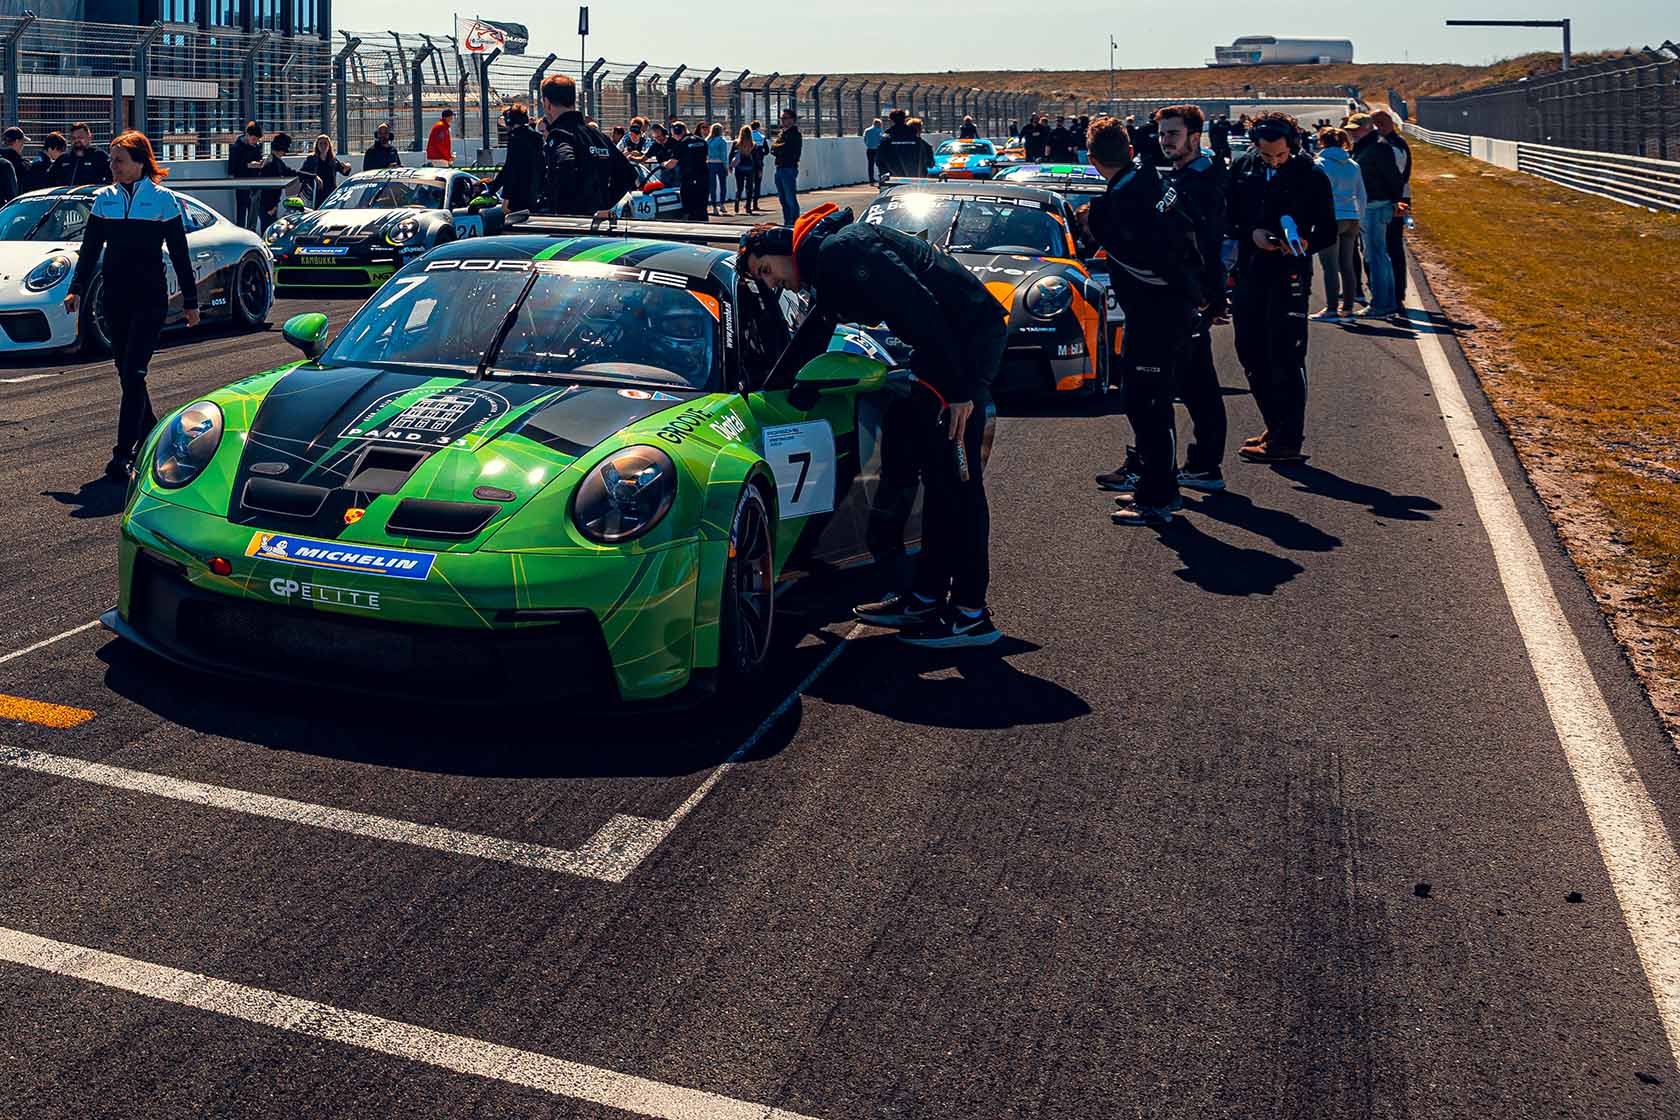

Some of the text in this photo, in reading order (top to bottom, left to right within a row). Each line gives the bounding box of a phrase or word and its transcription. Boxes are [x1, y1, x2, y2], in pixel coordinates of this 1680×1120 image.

[637, 200, 651, 215] 46
[456, 223, 478, 240] 24
[377, 275, 430, 309] 7
[348, 427, 469, 448] PAND 33
[656, 406, 715, 445] GROOVE
[709, 408, 746, 442] Digital
[787, 451, 811, 504] 7
[294, 546, 419, 570] MICHELIN
